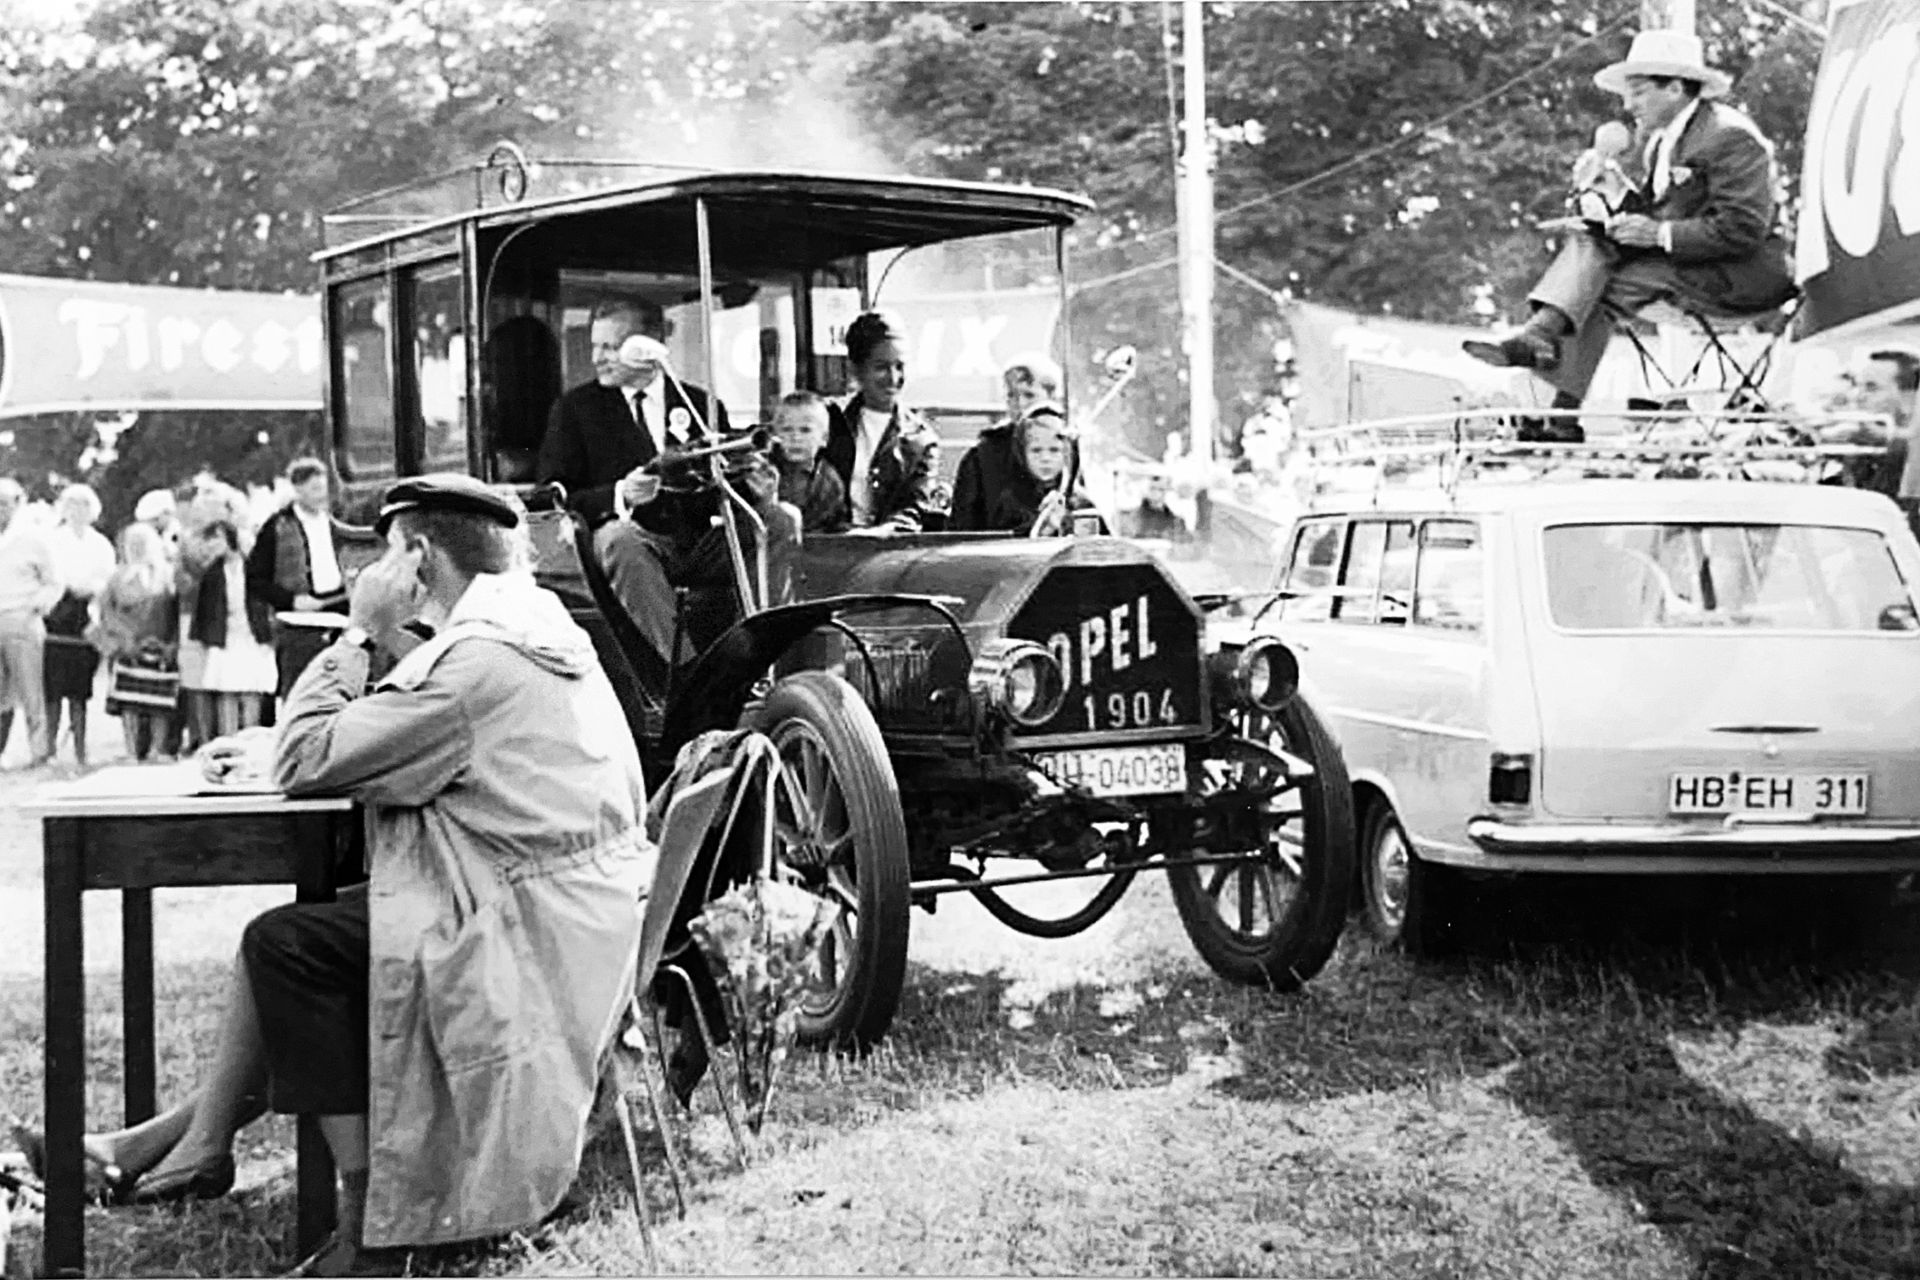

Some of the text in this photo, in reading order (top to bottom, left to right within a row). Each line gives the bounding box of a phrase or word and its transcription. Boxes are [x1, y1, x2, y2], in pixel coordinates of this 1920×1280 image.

[1048, 594, 1157, 693] OPEL
[1084, 688, 1177, 730] 1904
[1815, 777, 1864, 808] 311
